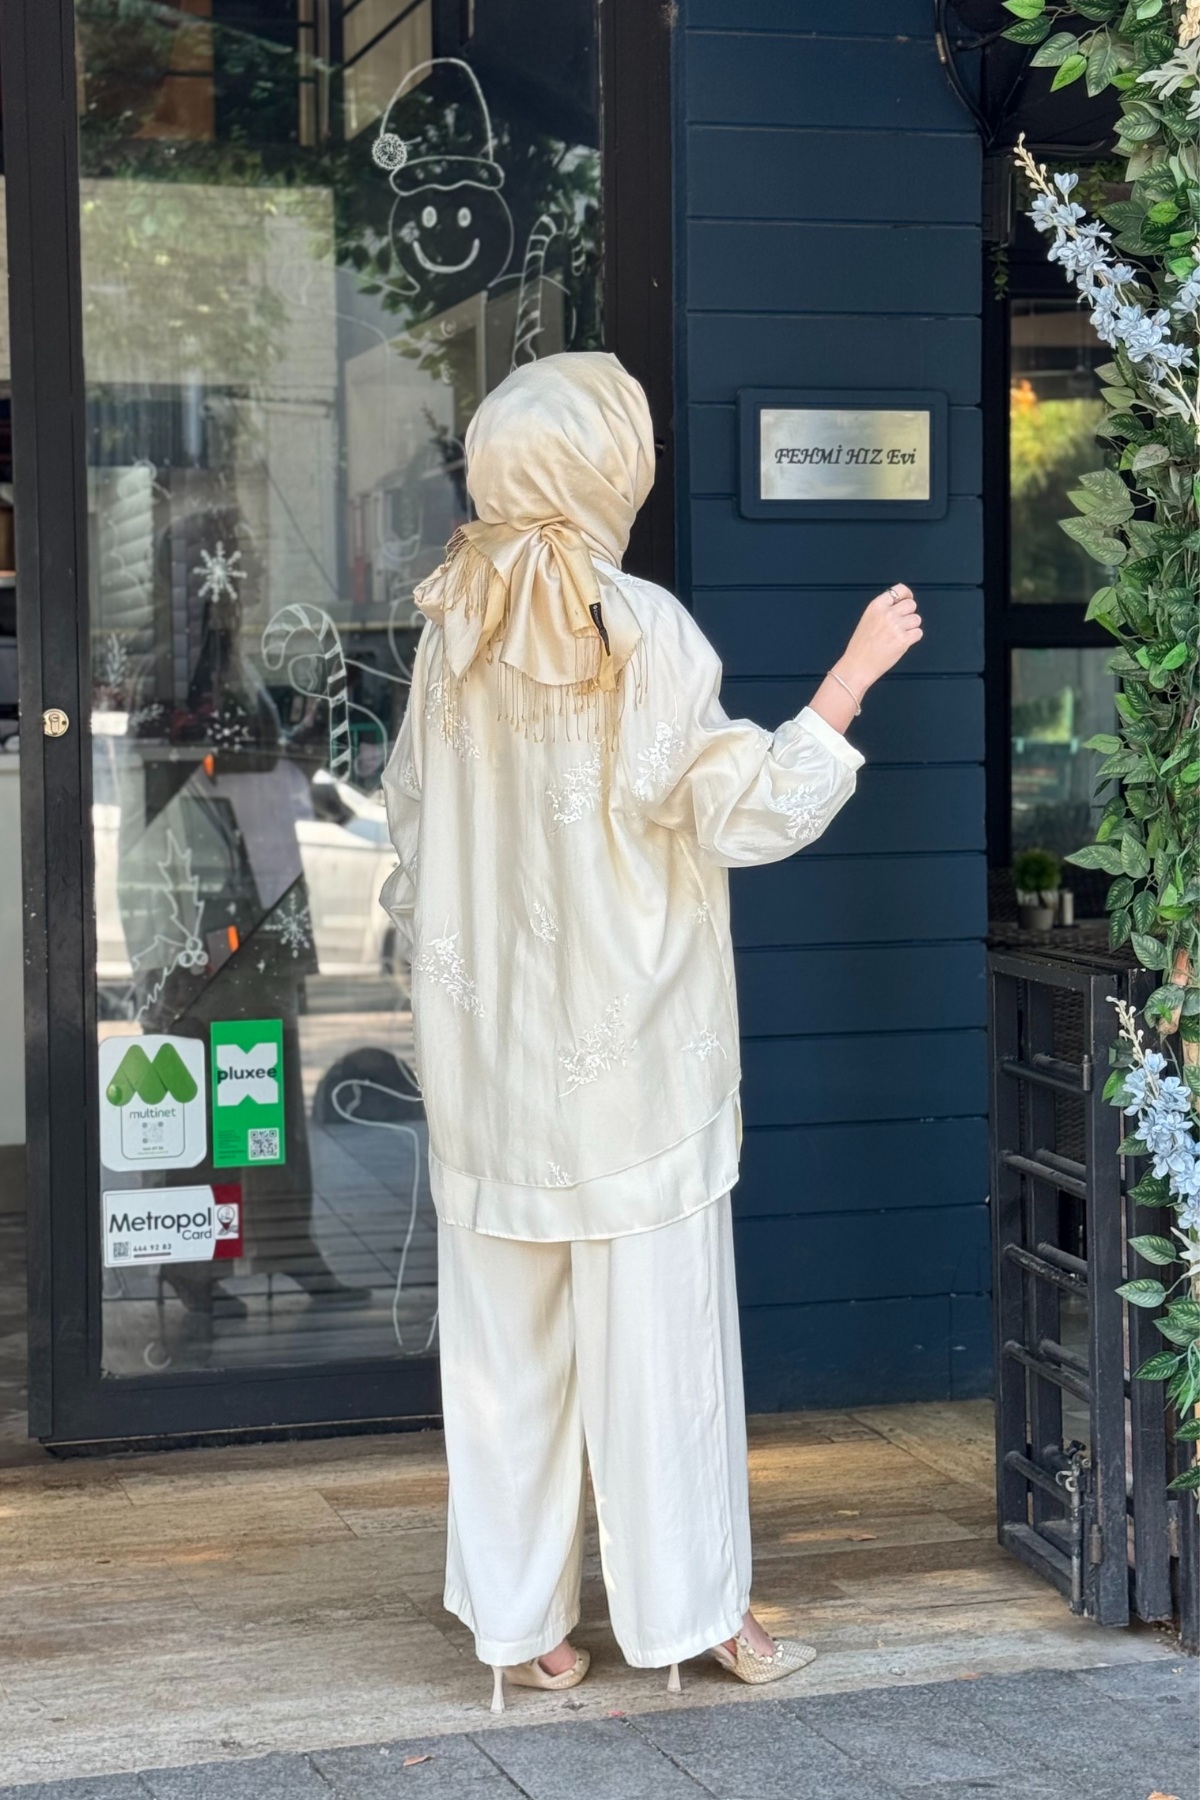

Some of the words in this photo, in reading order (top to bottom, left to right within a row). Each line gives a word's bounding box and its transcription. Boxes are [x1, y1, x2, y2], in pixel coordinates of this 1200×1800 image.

[774, 445, 843, 465] FEHMİ
[845, 448, 883, 465] HIZ
[886, 448, 917, 465] Evi
[217, 1066, 278, 1085] pluxee
[129, 1107, 177, 1119] multinet
[109, 1207, 212, 1234] Metropol
[182, 1228, 212, 1240] Card
